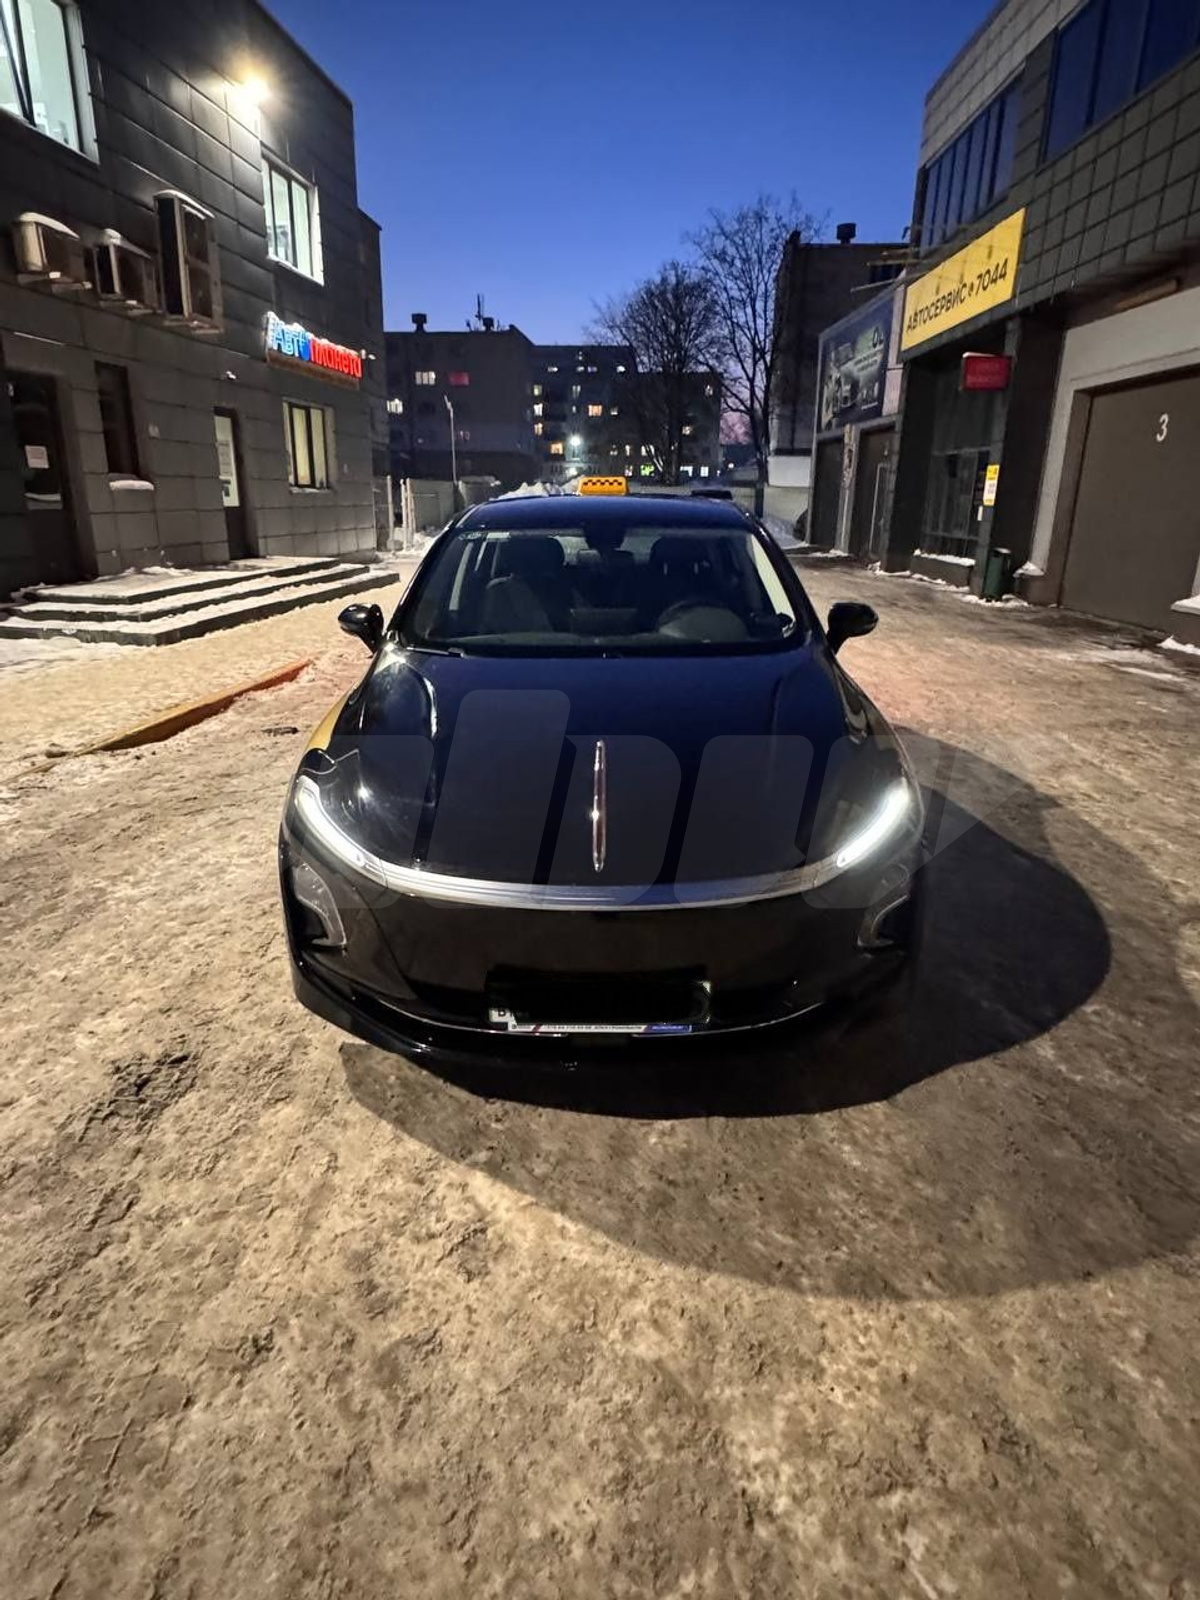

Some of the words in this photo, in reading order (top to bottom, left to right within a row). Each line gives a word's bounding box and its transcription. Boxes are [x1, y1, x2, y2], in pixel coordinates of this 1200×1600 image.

[906, 282, 967, 332] АВТОСЕРВИС
[975, 257, 1009, 296] 7044
[1156, 412, 1169, 443] 3
